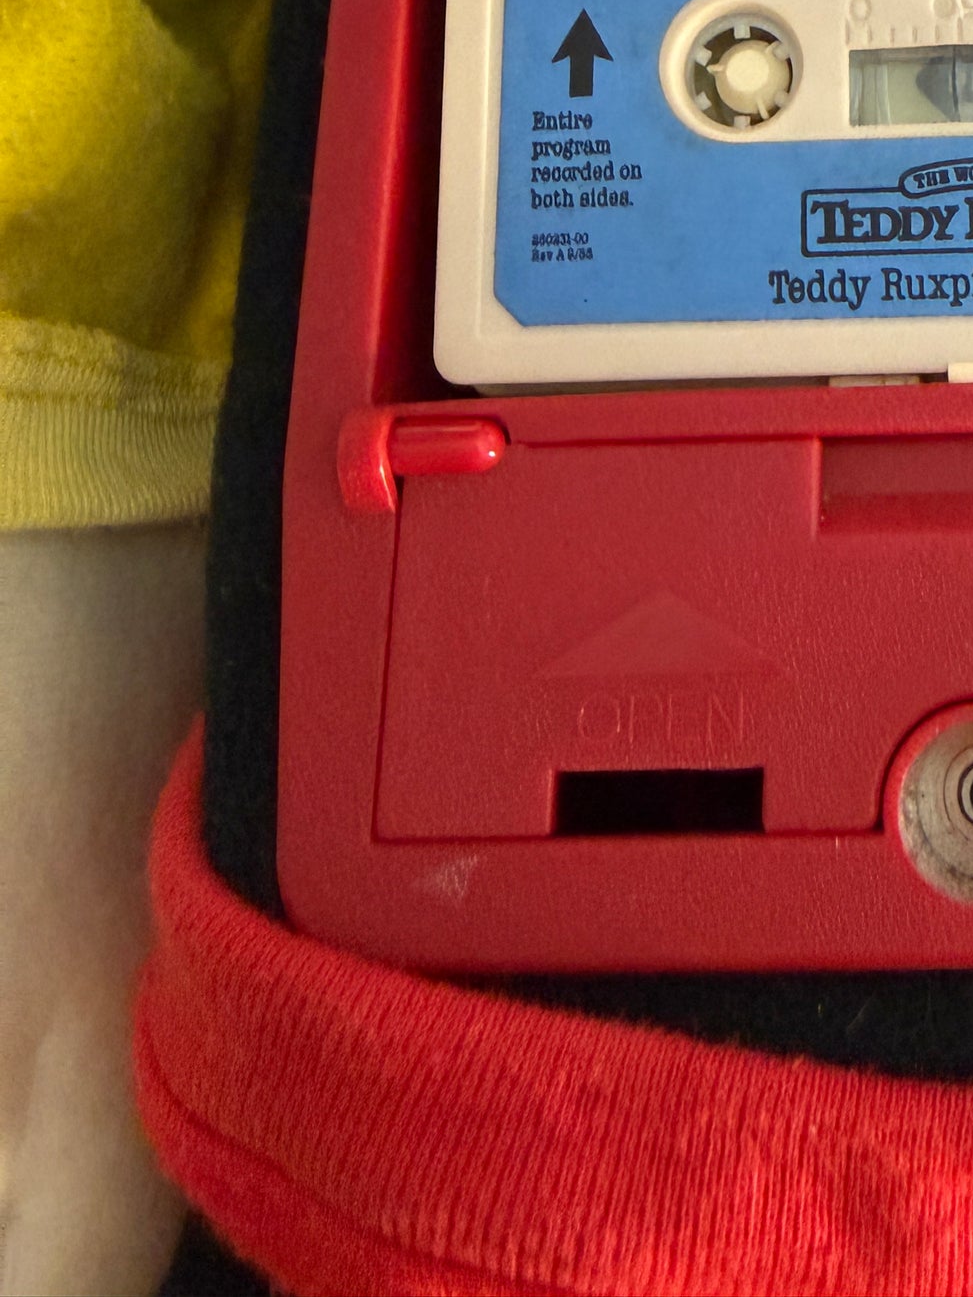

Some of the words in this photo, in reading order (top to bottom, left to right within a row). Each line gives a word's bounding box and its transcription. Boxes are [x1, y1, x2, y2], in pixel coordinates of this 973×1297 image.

[532, 111, 592, 131] Entire
[531, 138, 612, 161] program
[531, 160, 614, 183] recorded
[619, 164, 642, 180] on
[912, 172, 950, 189] THE
[531, 189, 574, 209] both
[580, 187, 633, 207] sides.
[811, 198, 959, 244] TEDDY
[768, 269, 871, 311] Teddy
